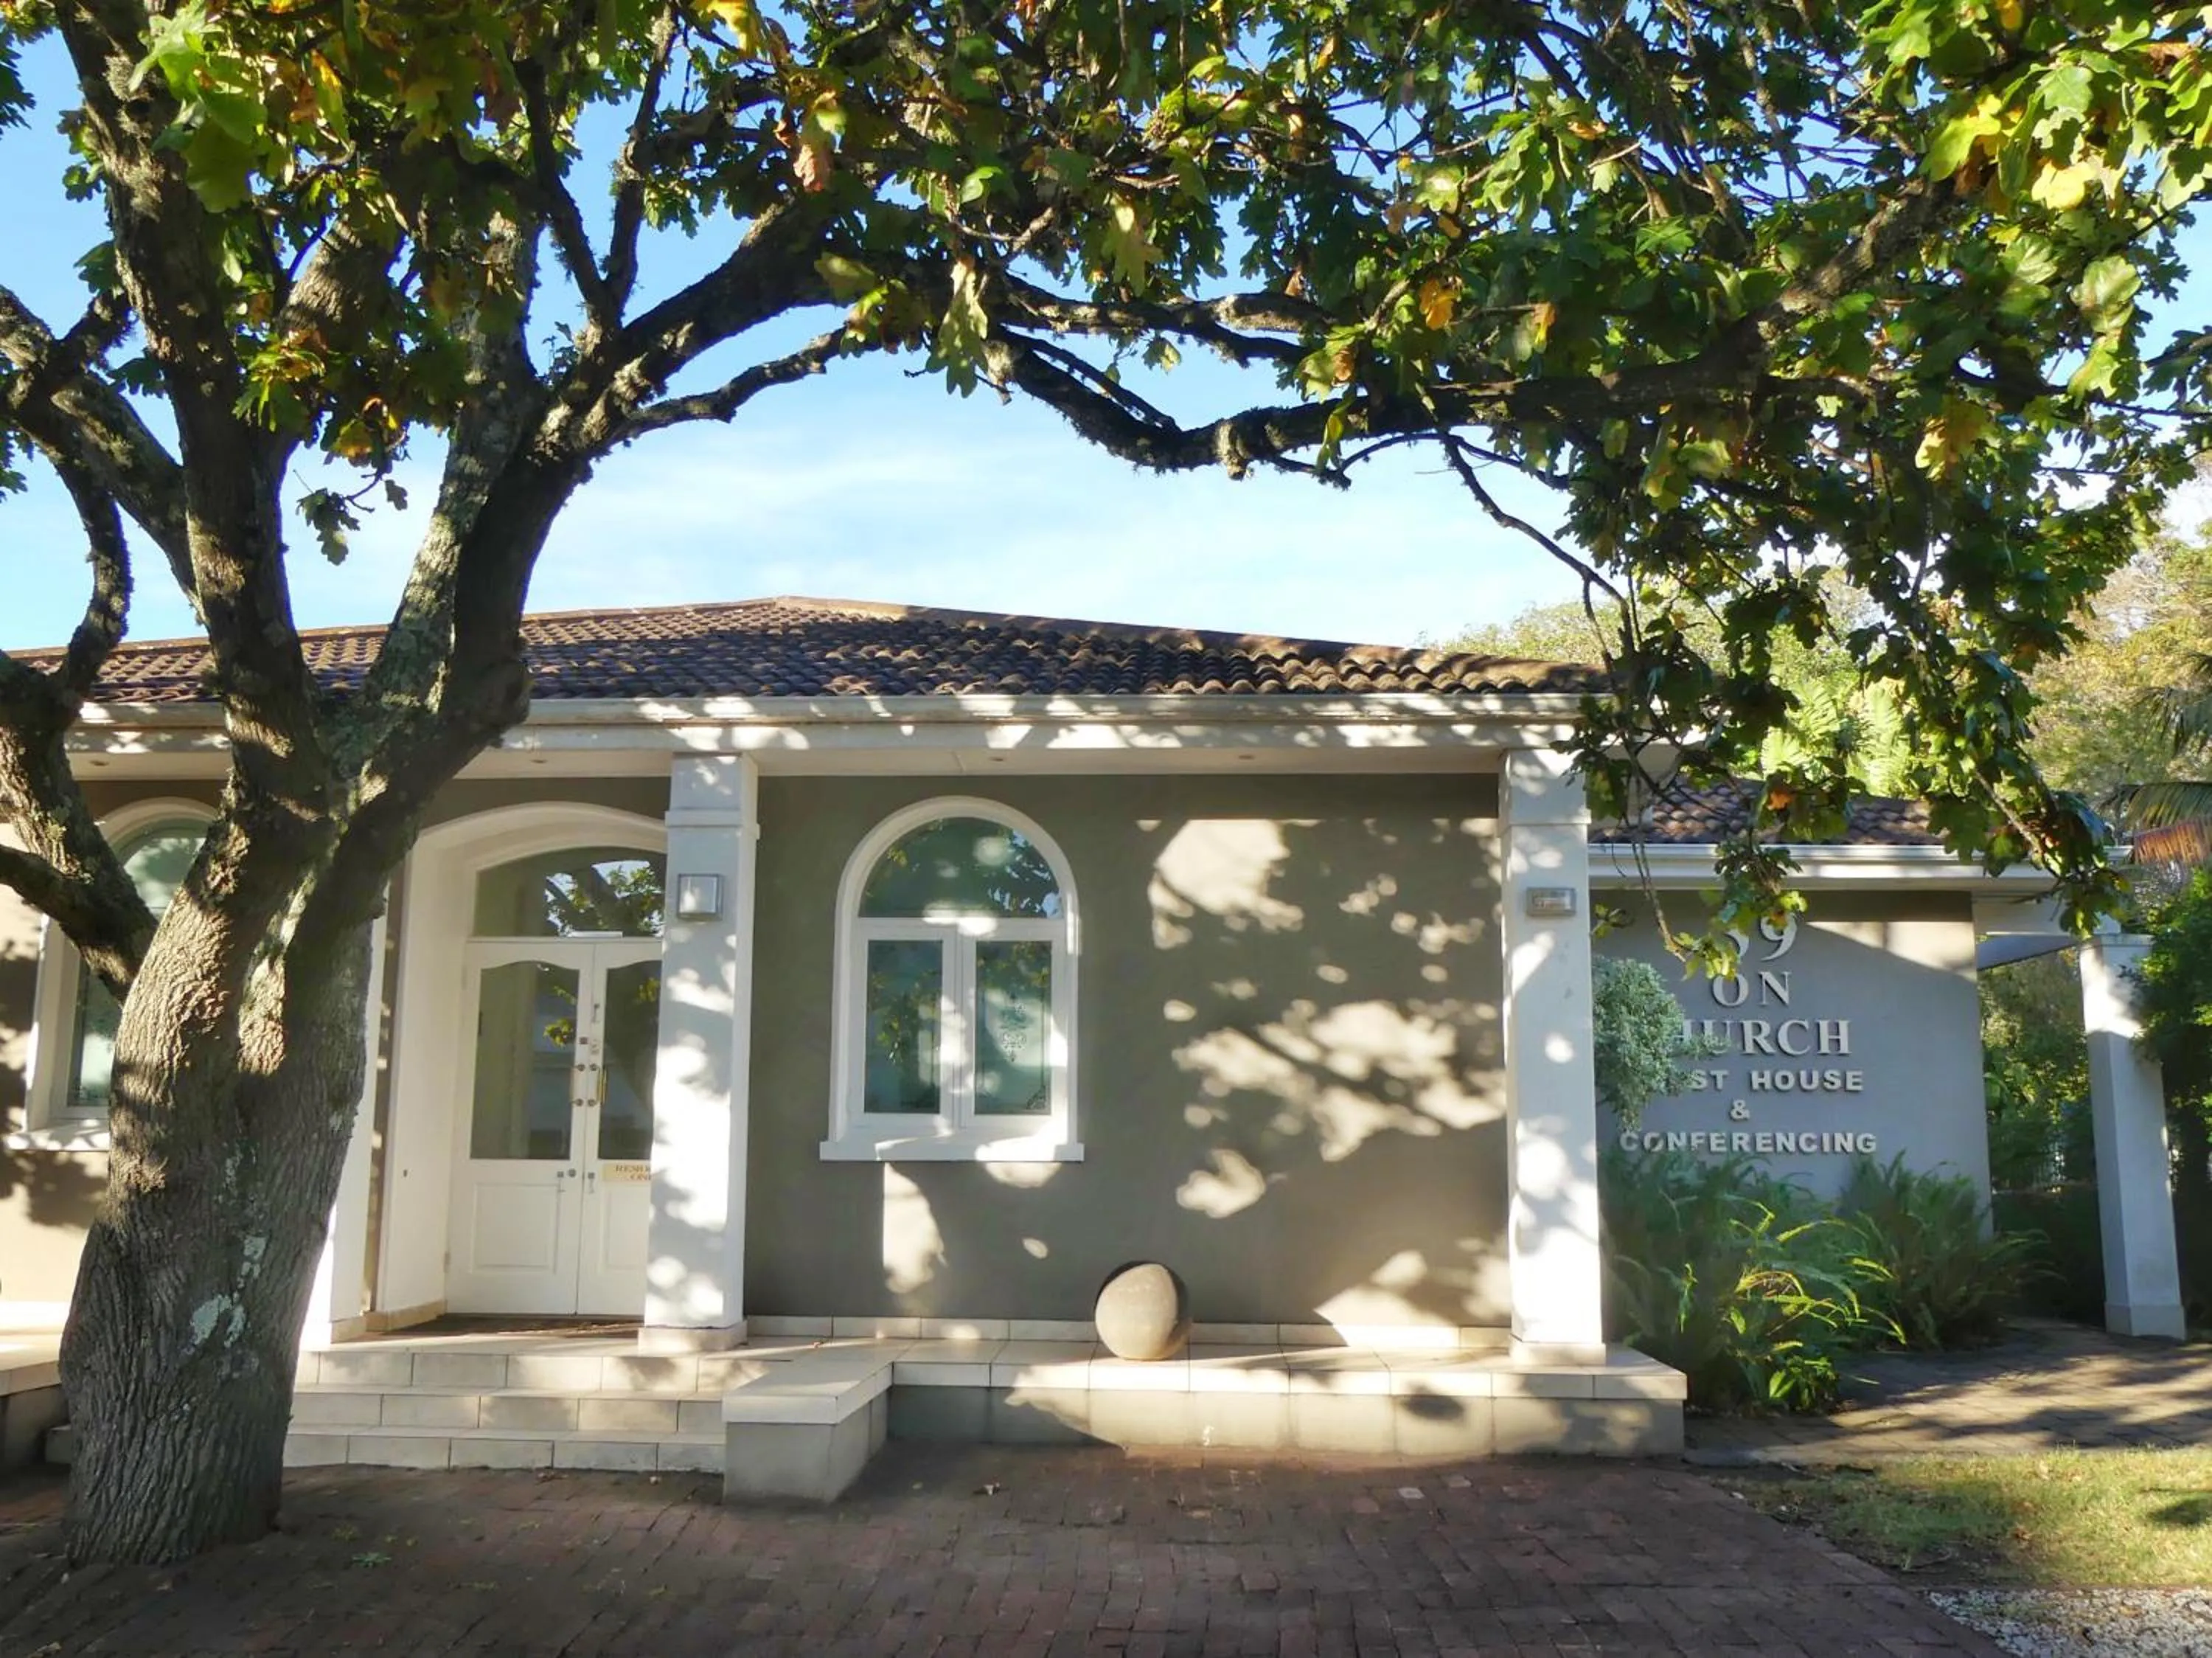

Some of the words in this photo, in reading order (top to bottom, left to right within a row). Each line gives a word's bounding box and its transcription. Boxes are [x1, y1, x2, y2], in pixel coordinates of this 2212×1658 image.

[1712, 971, 1792, 1007] ON
[1750, 1069, 1863, 1091] HOUSE
[1730, 1100, 1750, 1120] &
[1620, 1131, 1877, 1153] CONFERENCING
